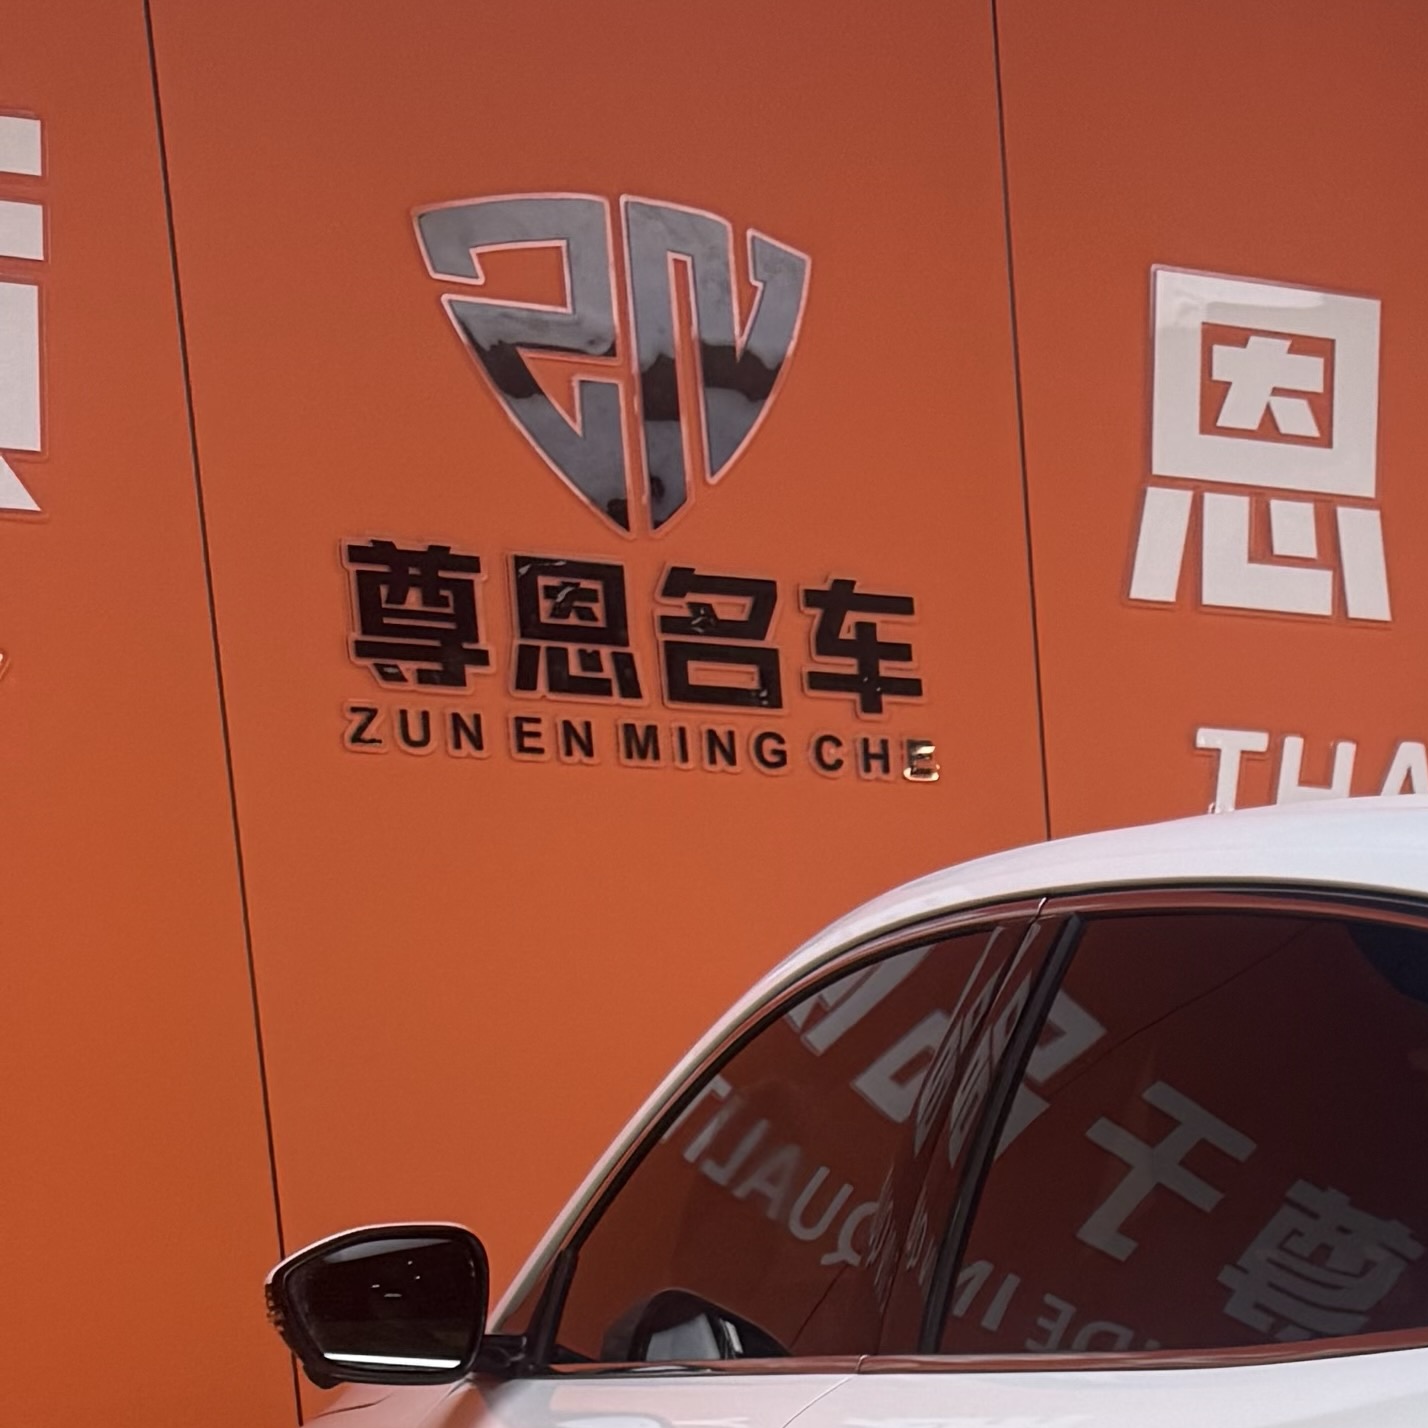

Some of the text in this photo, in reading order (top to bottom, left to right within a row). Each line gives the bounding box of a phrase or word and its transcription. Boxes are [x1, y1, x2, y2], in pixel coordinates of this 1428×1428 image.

[345, 538, 924, 716] 尊恩名车
[344, 704, 941, 784] ZUN EN MING CHE
